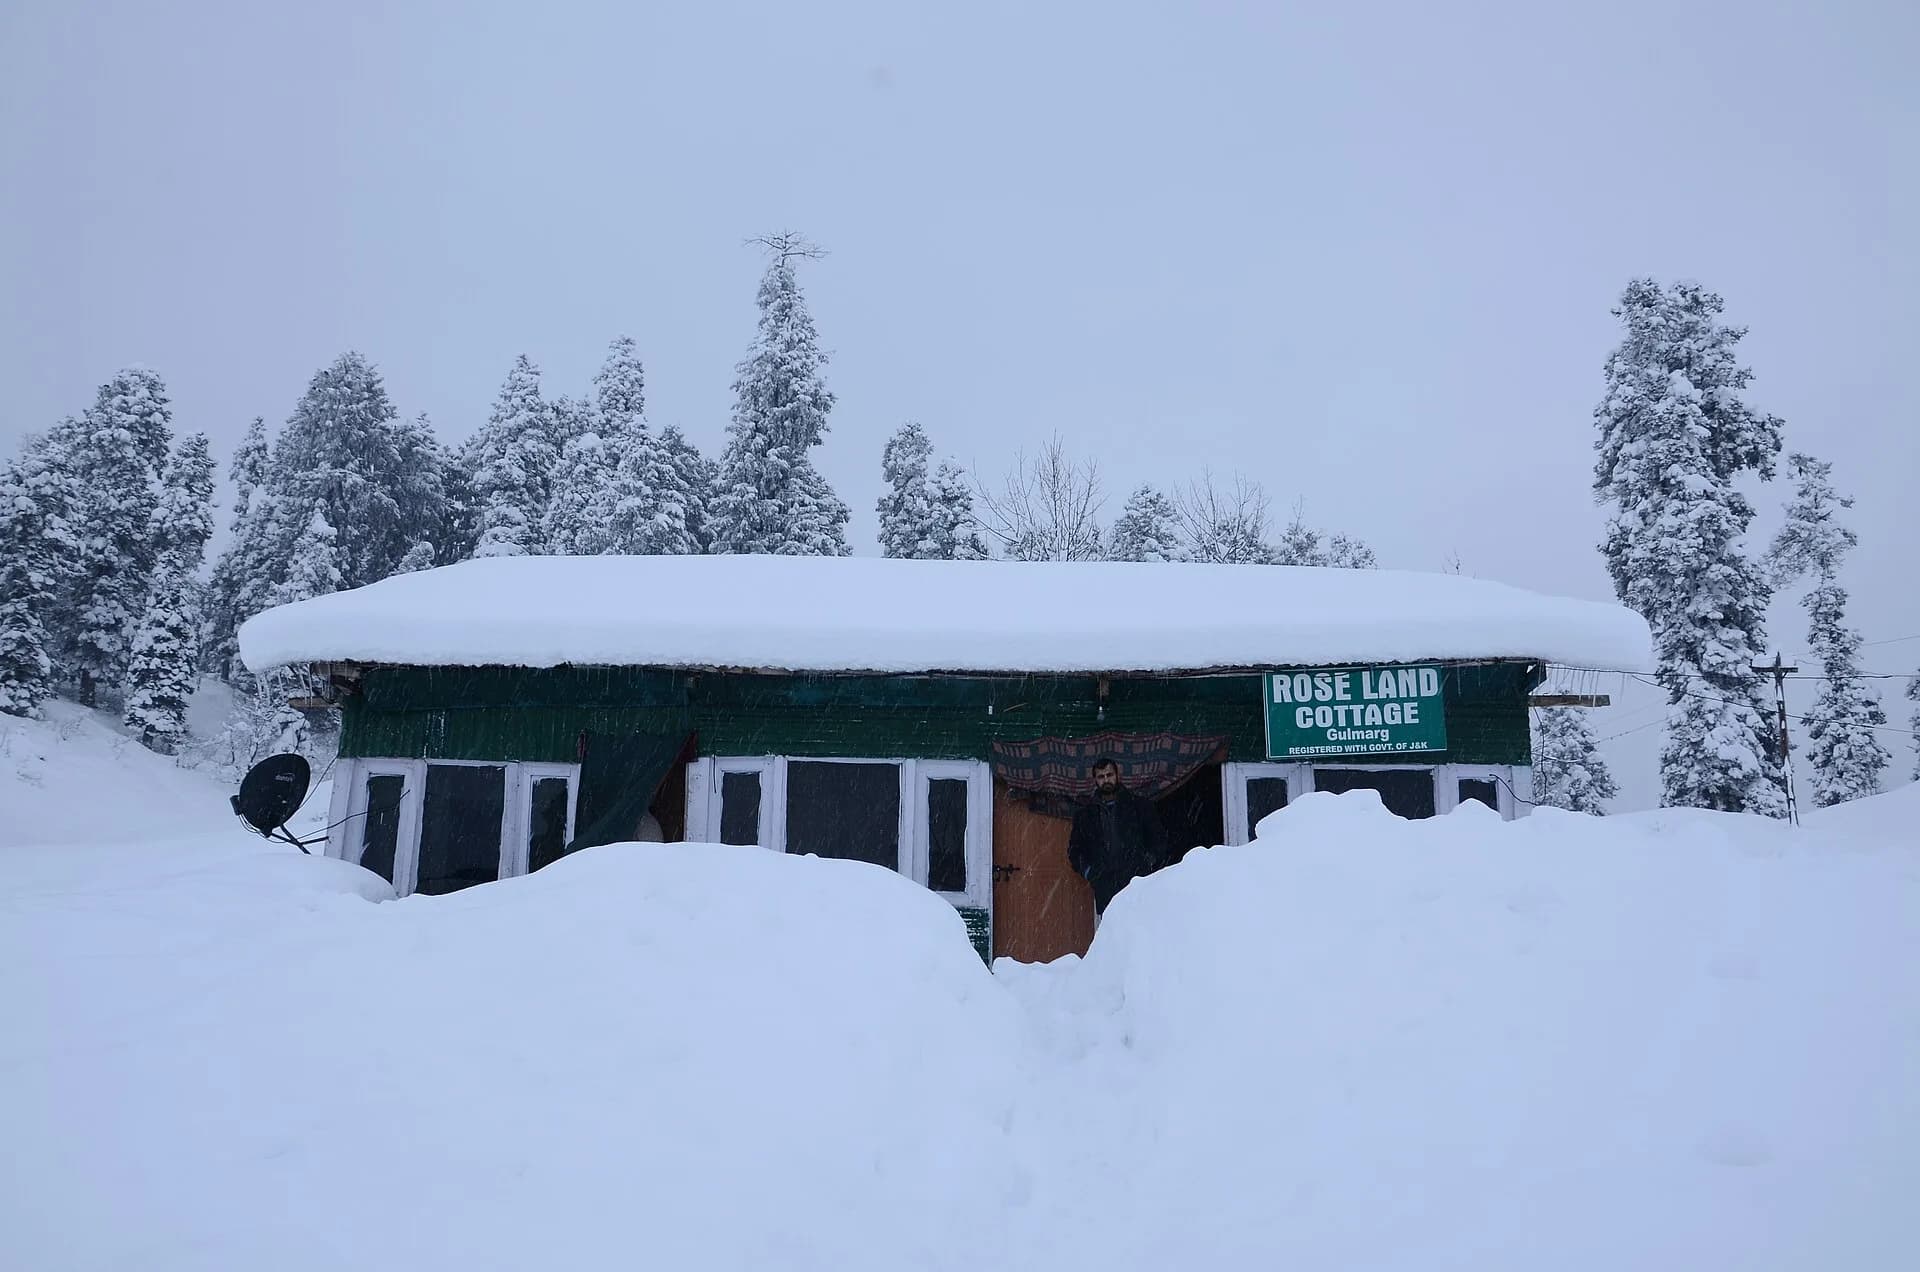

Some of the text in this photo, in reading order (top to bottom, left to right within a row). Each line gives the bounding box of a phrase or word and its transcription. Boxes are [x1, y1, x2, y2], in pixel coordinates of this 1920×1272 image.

[1273, 668, 1439, 703] ROSE LAND
[1296, 702, 1419, 728] COTTAGE
[1326, 728, 1390, 741] Gulmarg
[1289, 741, 1428, 755] REGISTERED WITH GOVT. OF J&K
